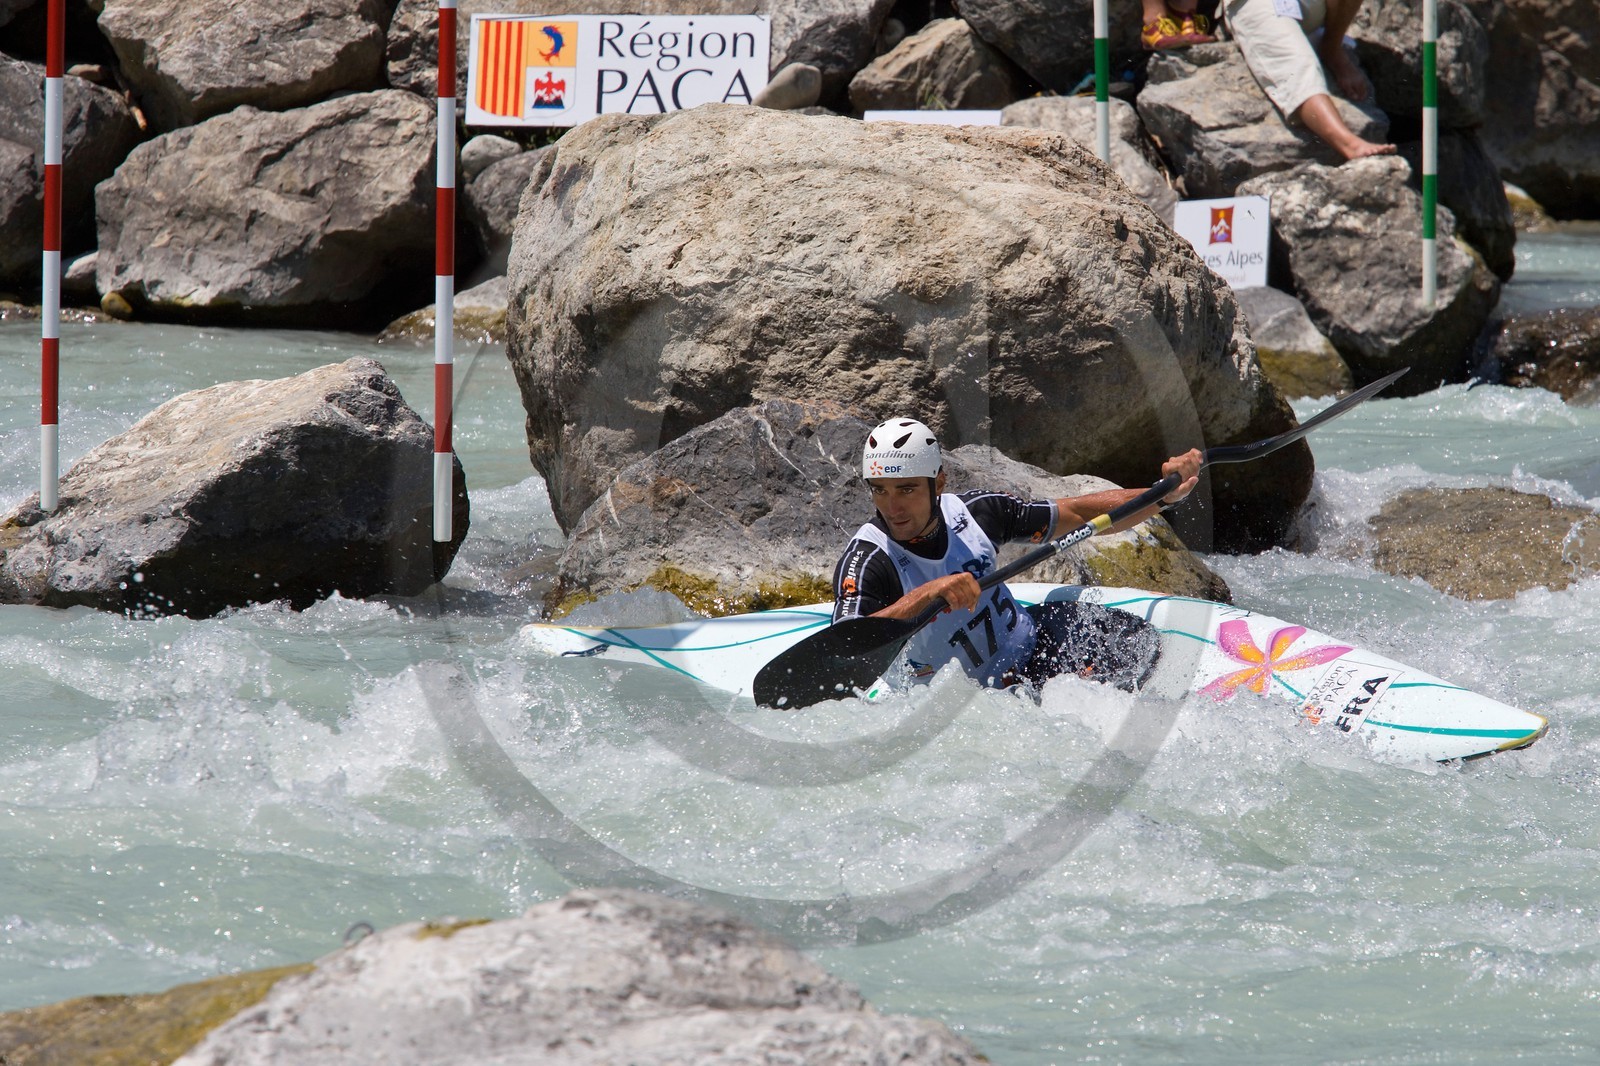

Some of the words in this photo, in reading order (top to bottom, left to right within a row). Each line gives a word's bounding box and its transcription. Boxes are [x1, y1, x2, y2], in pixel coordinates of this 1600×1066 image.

[598, 20, 755, 71] Région
[596, 68, 753, 114] PACA
[1226, 249, 1264, 269] Alpes
[1059, 525, 1092, 549] adidas
[948, 583, 1018, 669] 175
[1323, 668, 1358, 703] PACA
[1335, 676, 1389, 732] FRA
